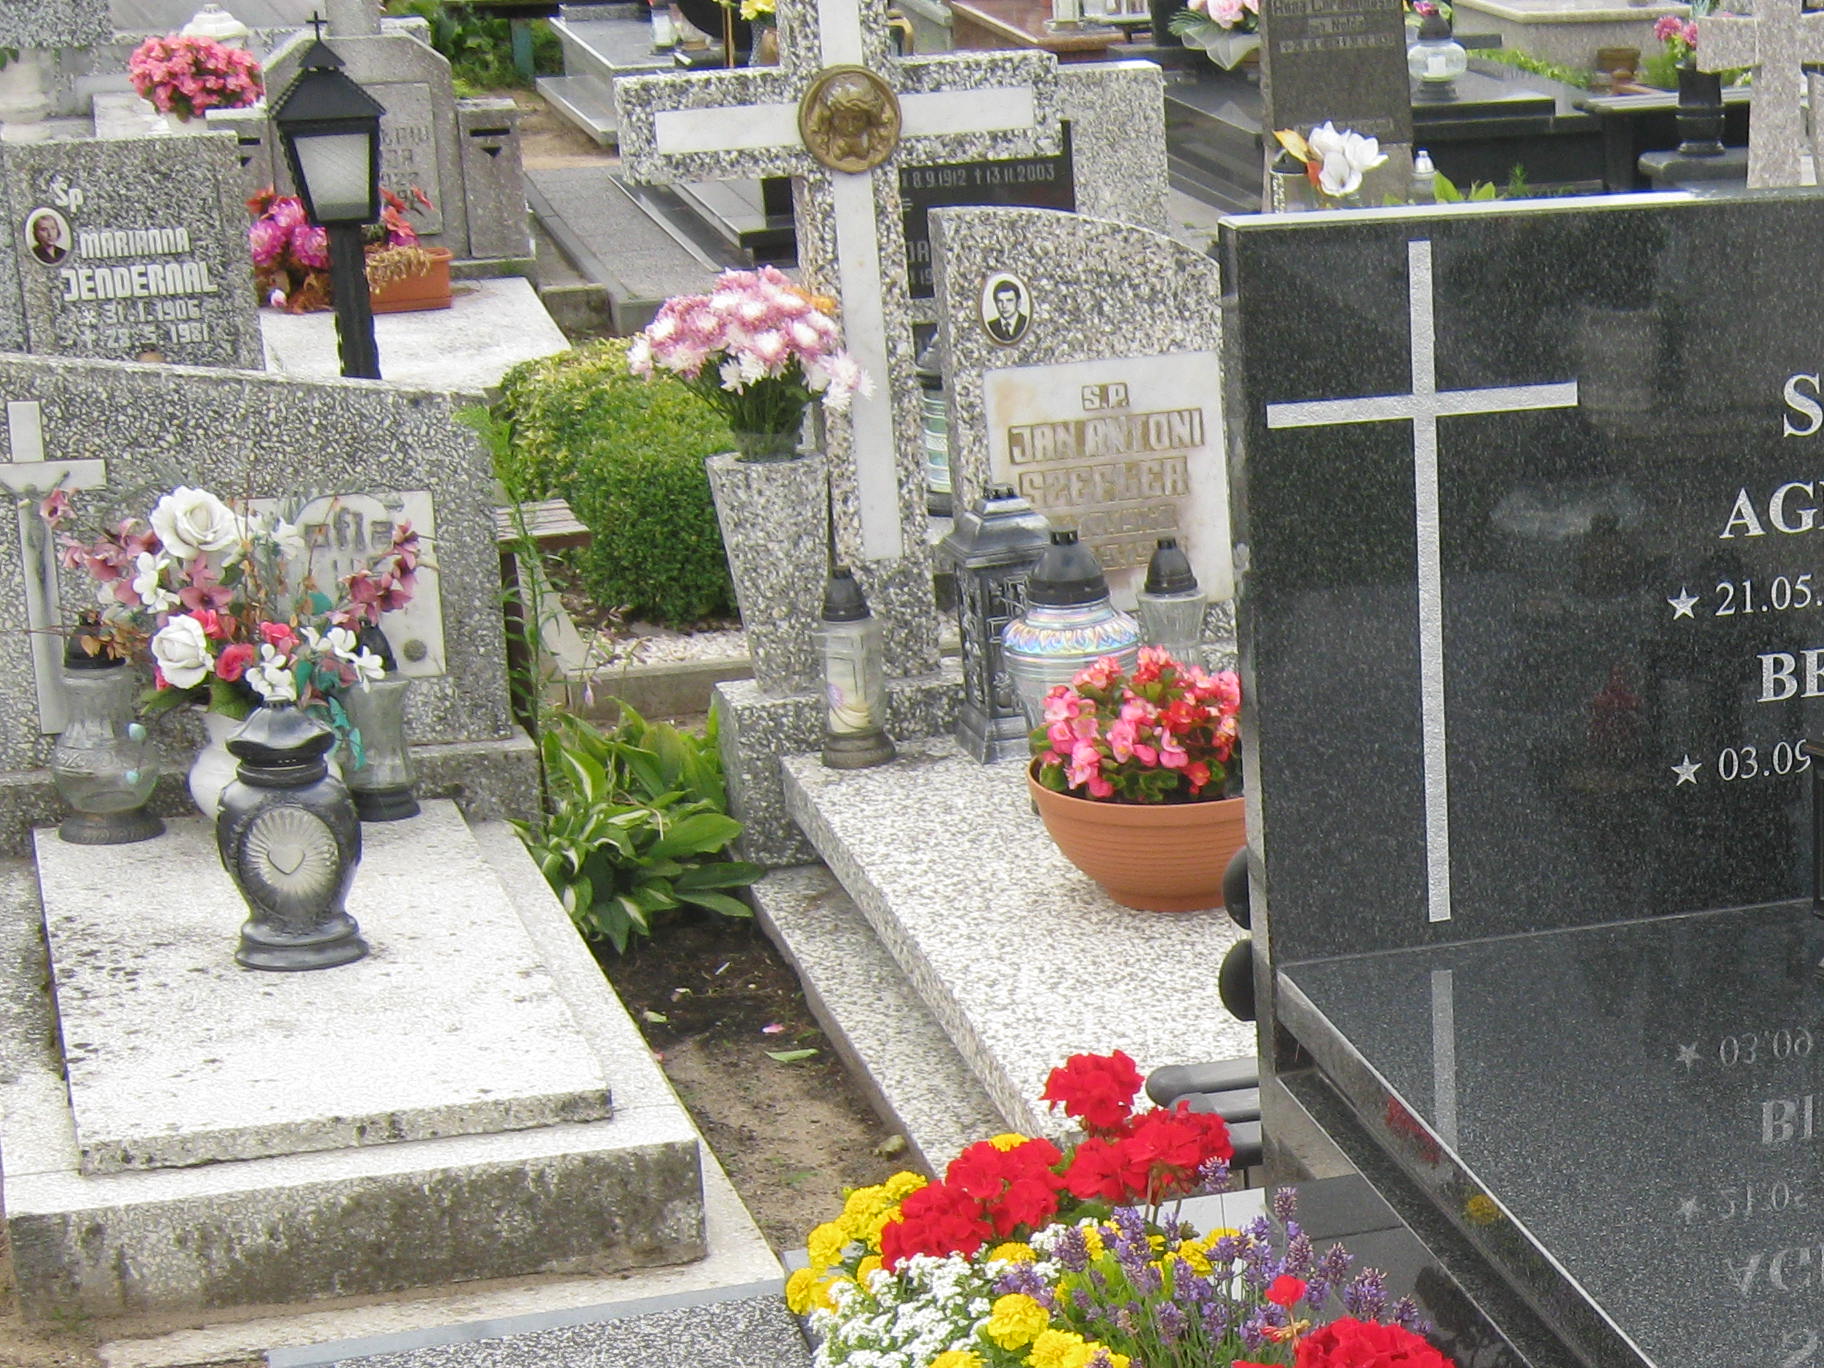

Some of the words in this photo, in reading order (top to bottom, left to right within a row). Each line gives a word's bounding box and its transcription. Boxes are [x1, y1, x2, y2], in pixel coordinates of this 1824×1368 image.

[79, 228, 191, 259] MARIANNA
[60, 261, 219, 302] JENDERNAL
[1008, 421, 1077, 465] JAN
[1084, 408, 1204, 457] ANTONI
[1717, 738, 1812, 783] 03.09
